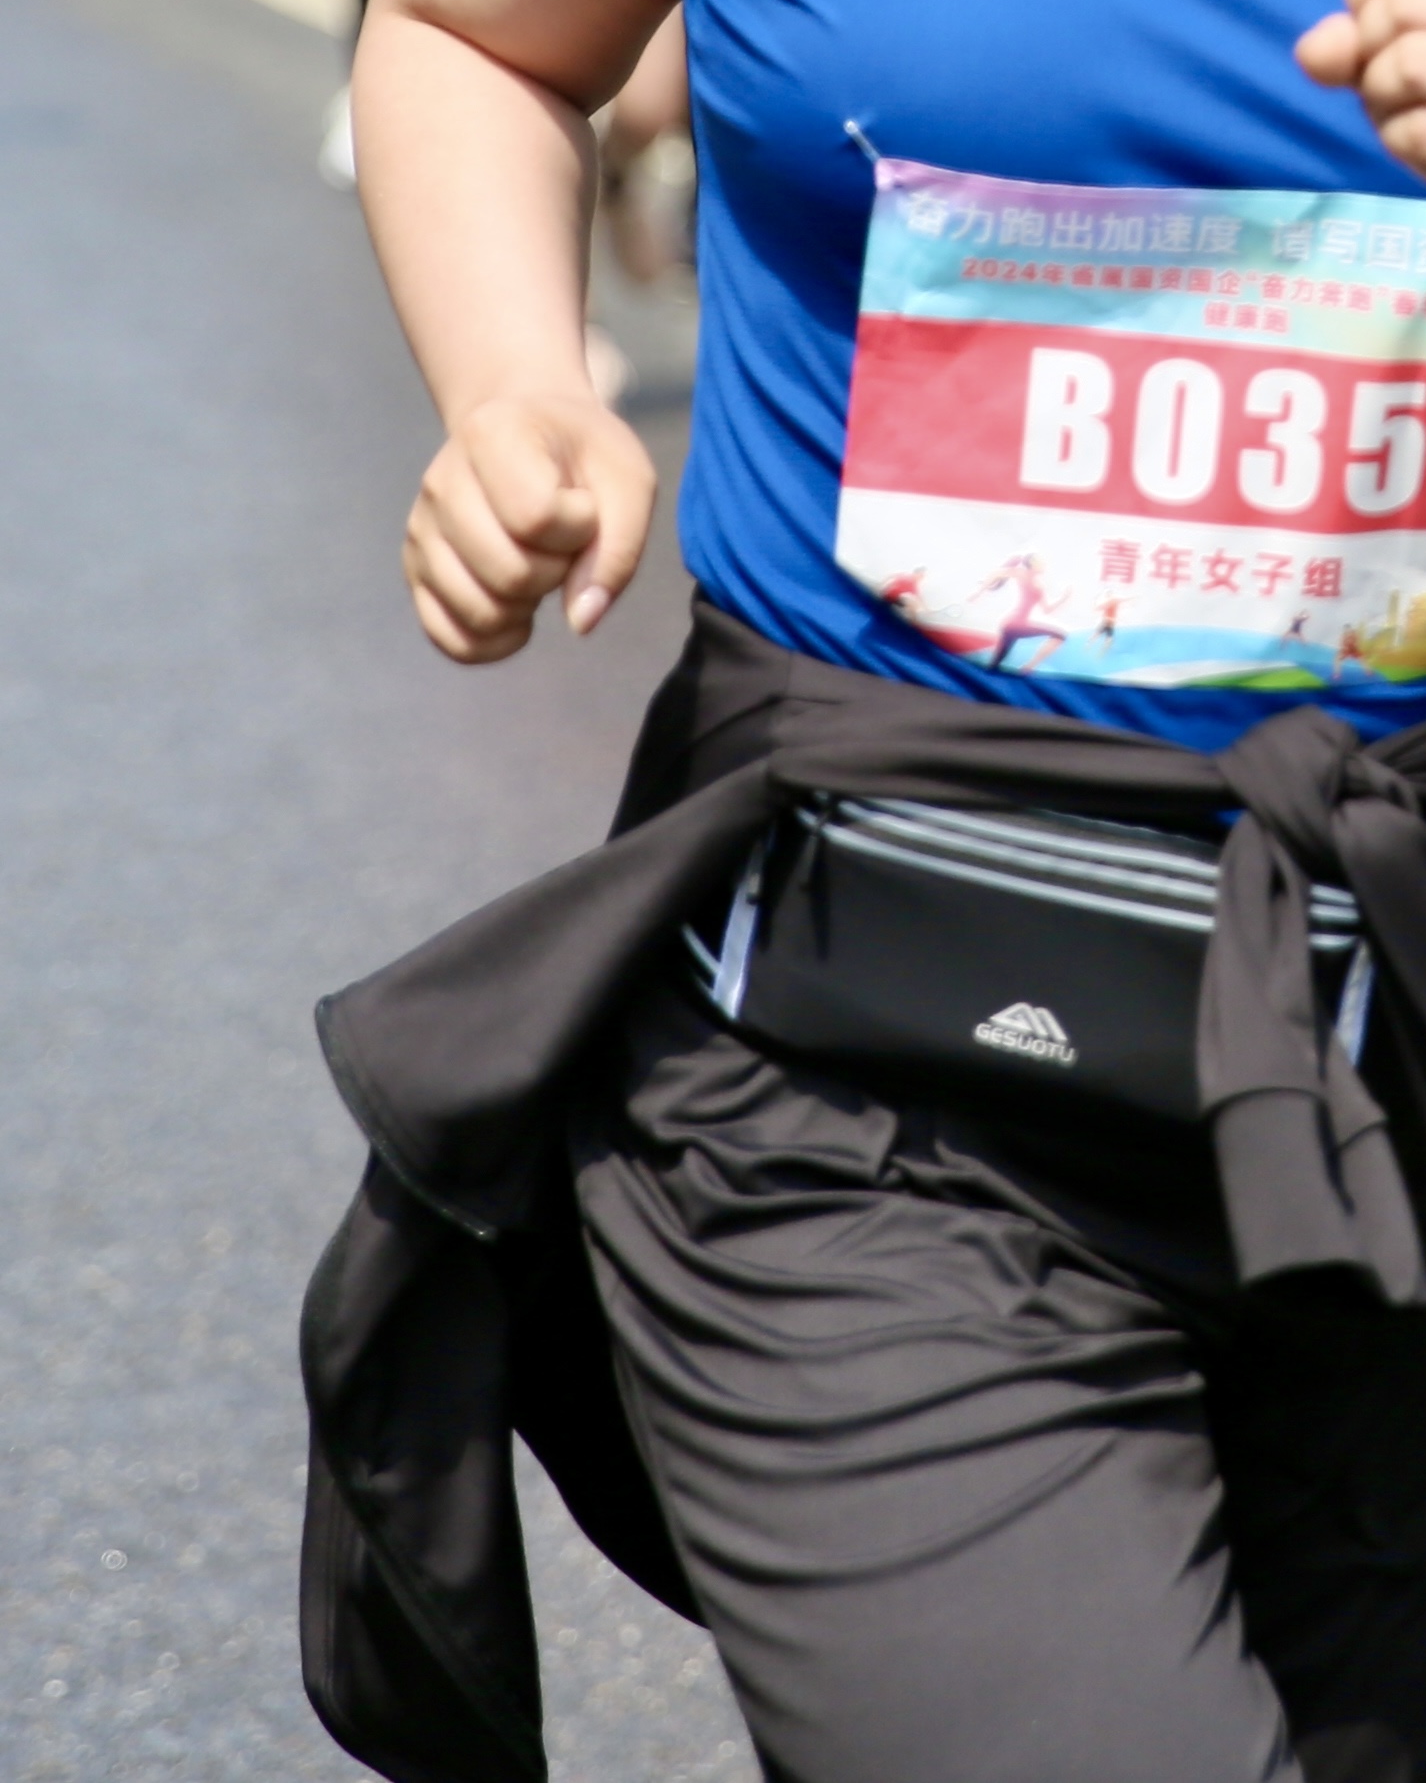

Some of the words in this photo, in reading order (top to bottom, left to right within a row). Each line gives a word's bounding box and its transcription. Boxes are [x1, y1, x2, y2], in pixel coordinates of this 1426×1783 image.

[906, 191, 1242, 254] 奋力跑出加速度
[1098, 537, 1344, 599] 青年女子组
[974, 1022, 1077, 1065] GESUOTU
